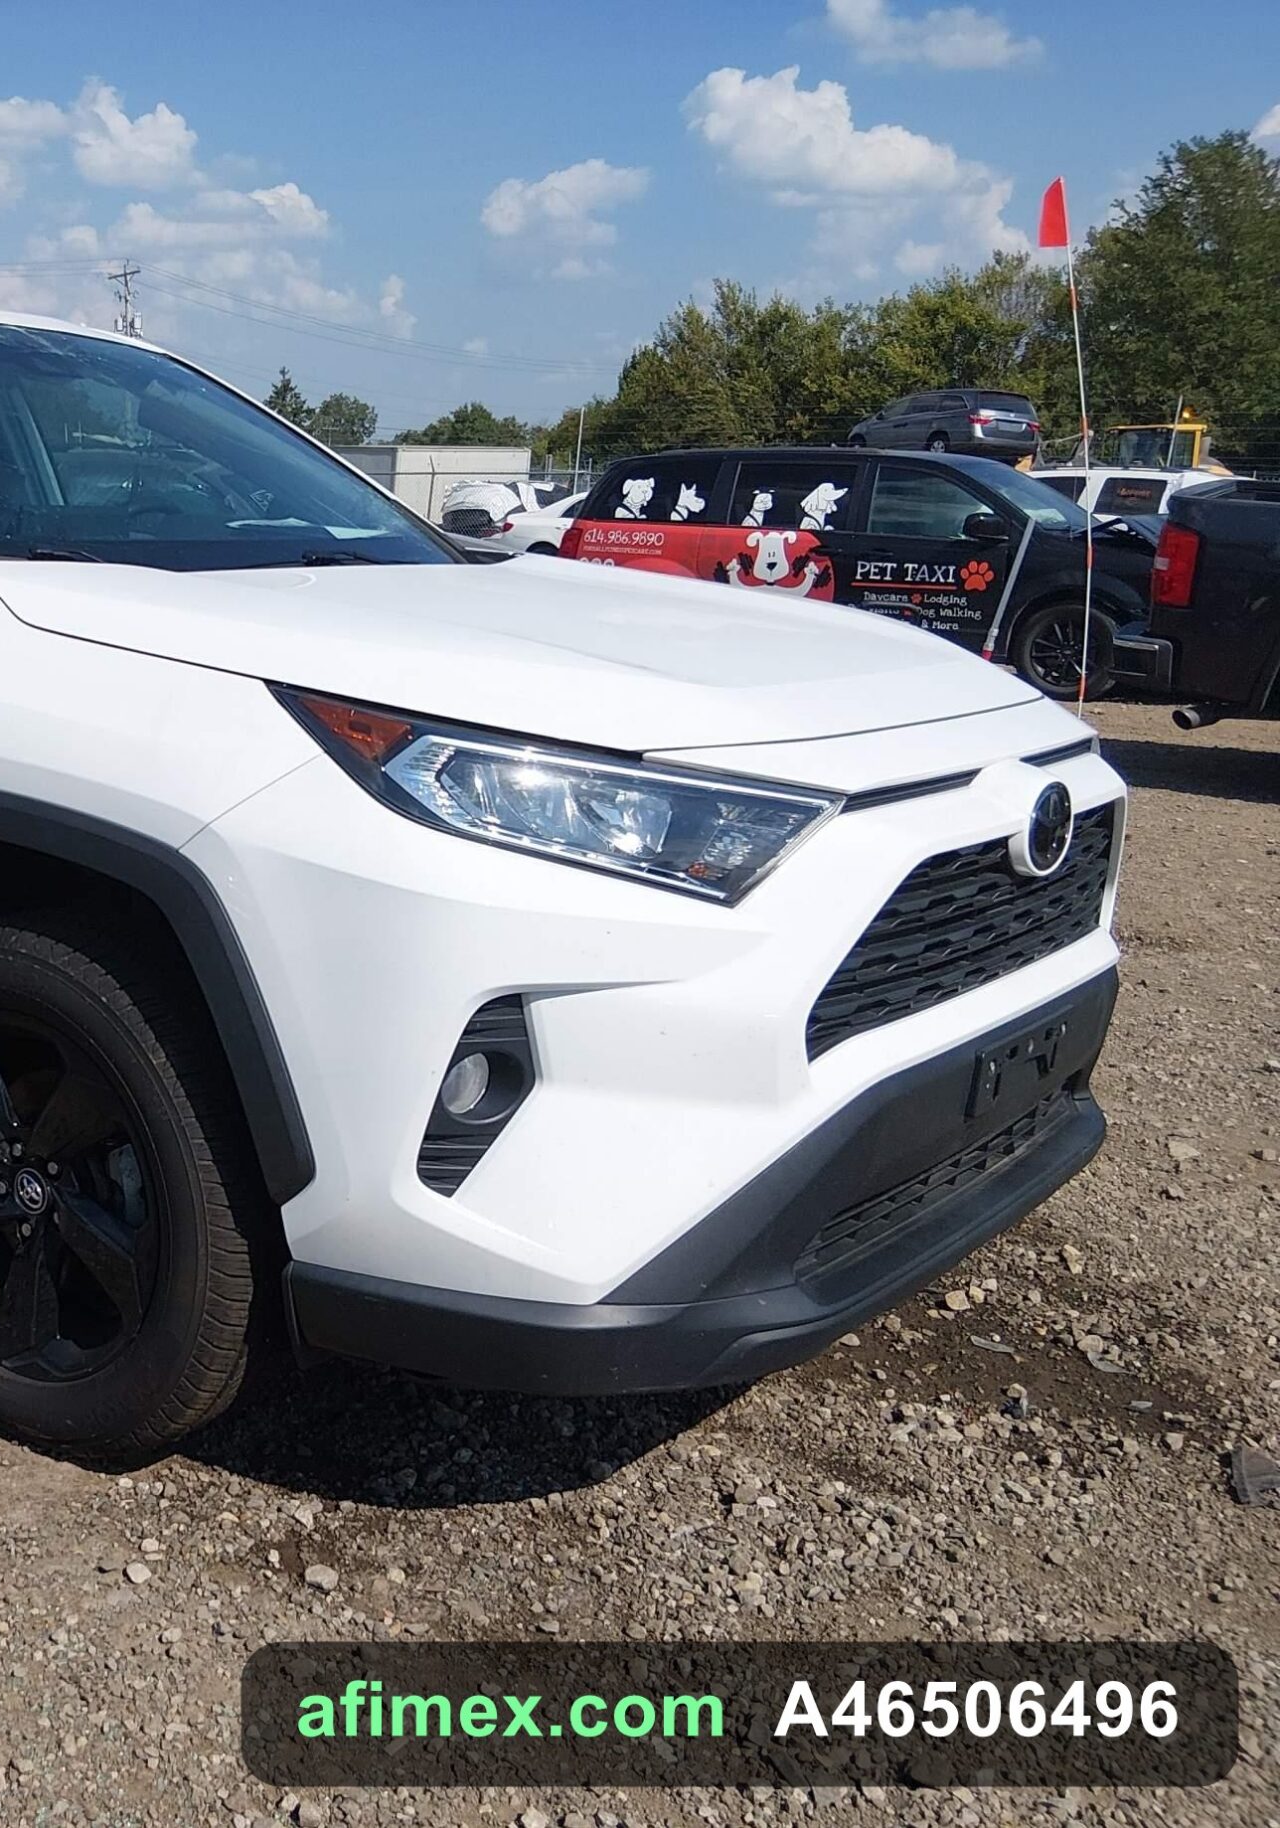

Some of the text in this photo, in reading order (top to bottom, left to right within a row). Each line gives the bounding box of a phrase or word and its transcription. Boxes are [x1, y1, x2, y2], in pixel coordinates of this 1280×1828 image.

[583, 528, 665, 547] 614.986.9890
[855, 560, 956, 583] PET TAXI
[923, 593, 967, 606] Lodging
[939, 607, 982, 620] Walking
[932, 620, 959, 630] More
